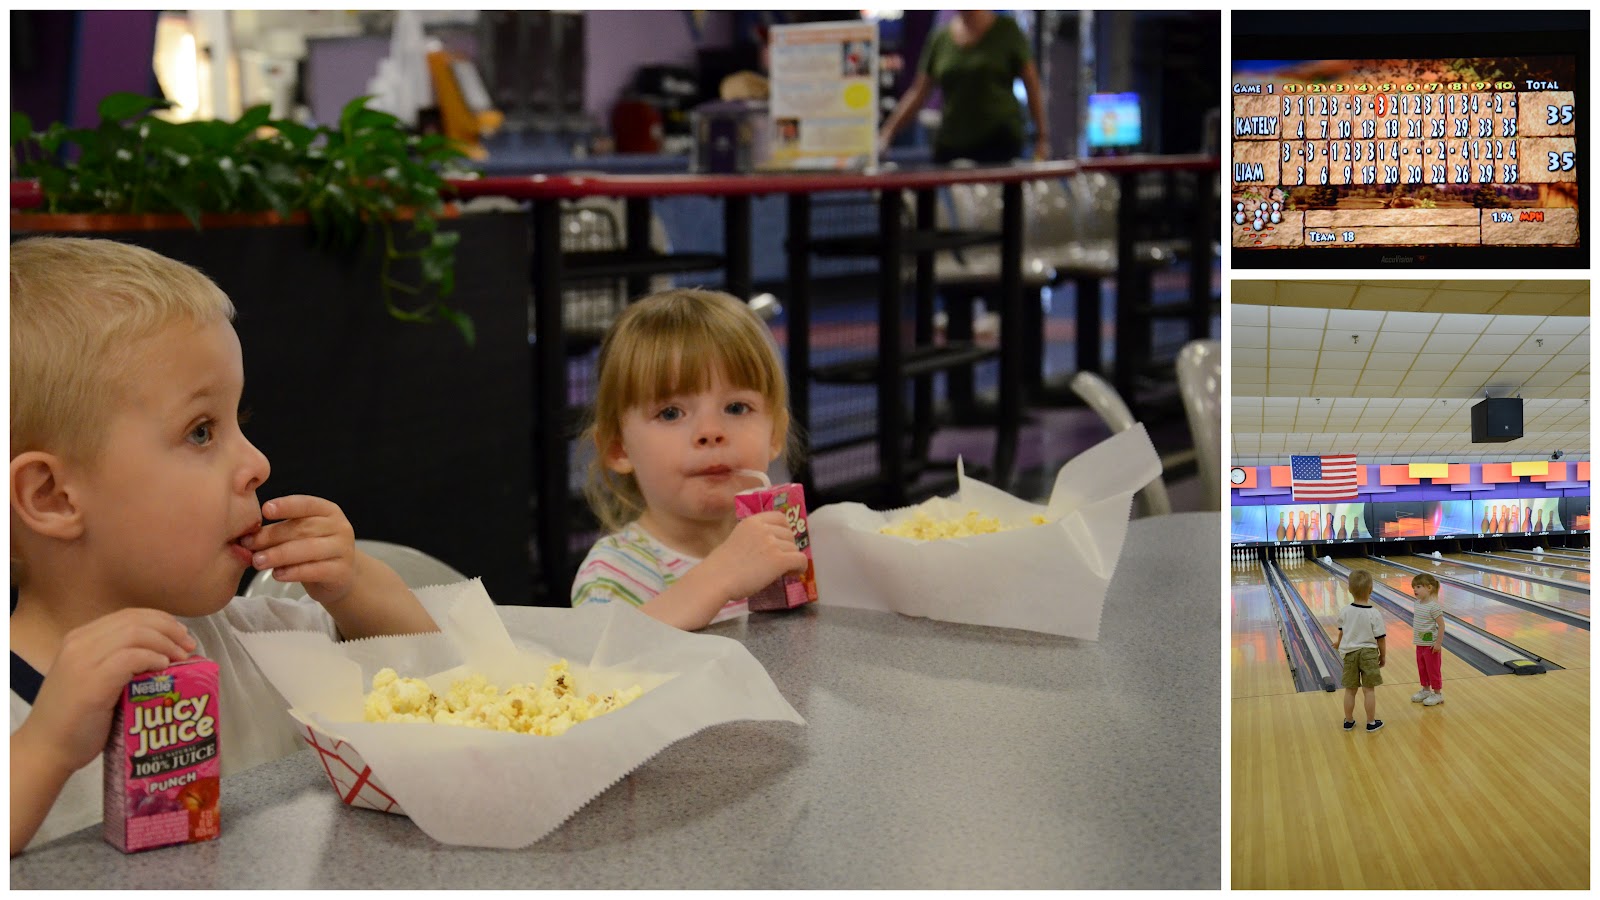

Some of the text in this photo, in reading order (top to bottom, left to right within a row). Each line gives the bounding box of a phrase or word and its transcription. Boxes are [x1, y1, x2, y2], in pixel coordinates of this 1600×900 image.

[1233, 84, 1273, 93] GAME 1
[1289, 84, 1296, 92] 1
[1359, 84, 1368, 92] 4
[1406, 83, 1414, 91] 6
[1430, 83, 1438, 91] 7
[1496, 82, 1512, 90] 10
[1526, 80, 1559, 89] TOTAL
[1283, 95, 1502, 116] 3 1 1 2 3 3 3 2 1 2 3 1 1 3 4 2
[1236, 117, 1277, 135] KATELY
[1297, 106, 1573, 138] 4 7 10 13 18 21 25 29 33 35 35
[1283, 141, 1516, 162] 3 3 1 2 3 3 1 4 2 4 1 2 2 4
[1235, 163, 1264, 182] LIAM
[1297, 152, 1574, 185] 3 6 9 15 20 20 22 26 29 35 35
[1492, 212, 1544, 222] 1.96 MPH
[1309, 232, 1355, 242] TEAM 18
[129, 694, 209, 734] Juicy
[134, 715, 215, 757] Juice
[136, 743, 216, 776] 100% JUICE
[150, 771, 197, 793] PUNCH
